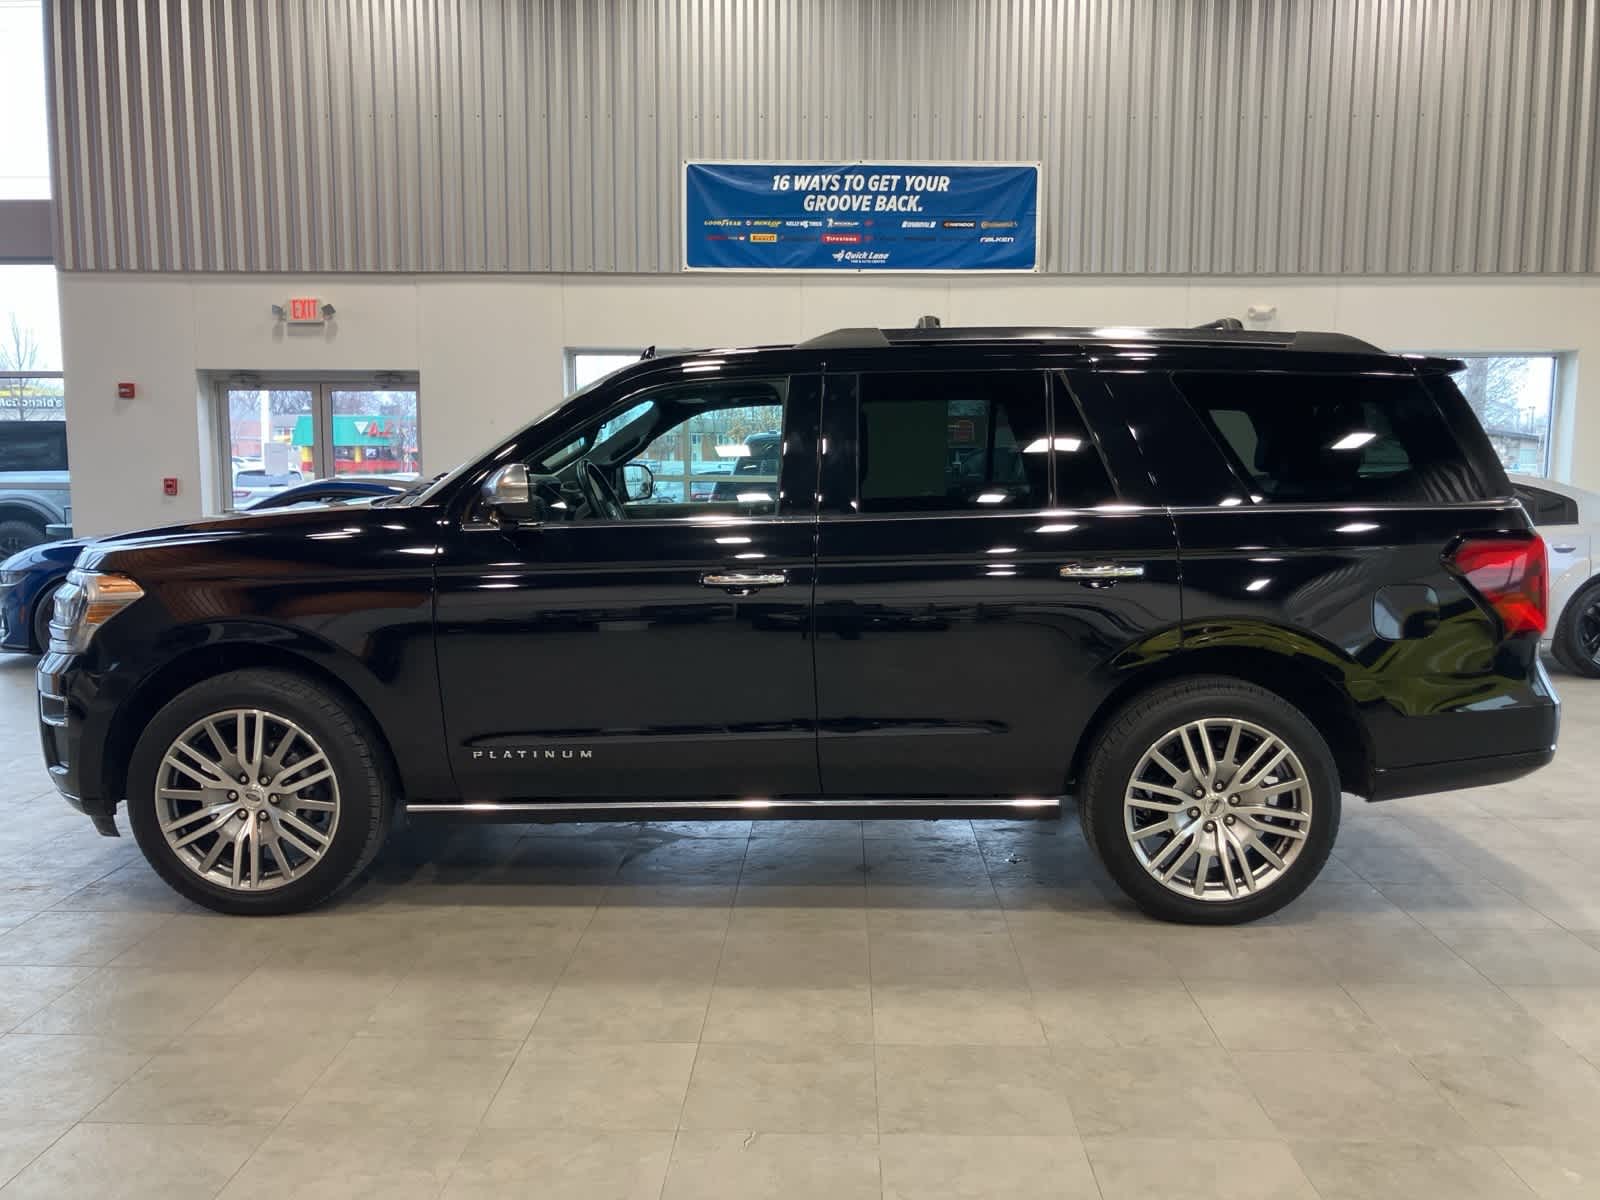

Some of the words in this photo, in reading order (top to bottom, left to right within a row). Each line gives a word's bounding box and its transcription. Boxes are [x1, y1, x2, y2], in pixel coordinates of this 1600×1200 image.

[772, 175, 790, 191] 16
[793, 175, 841, 191] WAYS
[844, 175, 865, 191] TO
[868, 175, 900, 191] GET
[904, 175, 951, 192] YOUR
[803, 195, 872, 212] GROOVE
[875, 195, 923, 212] BACK.
[845, 251, 868, 260] Quick
[868, 251, 889, 260] Lane
[291, 299, 317, 320] EXIT
[472, 750, 593, 759] PLATINUM
